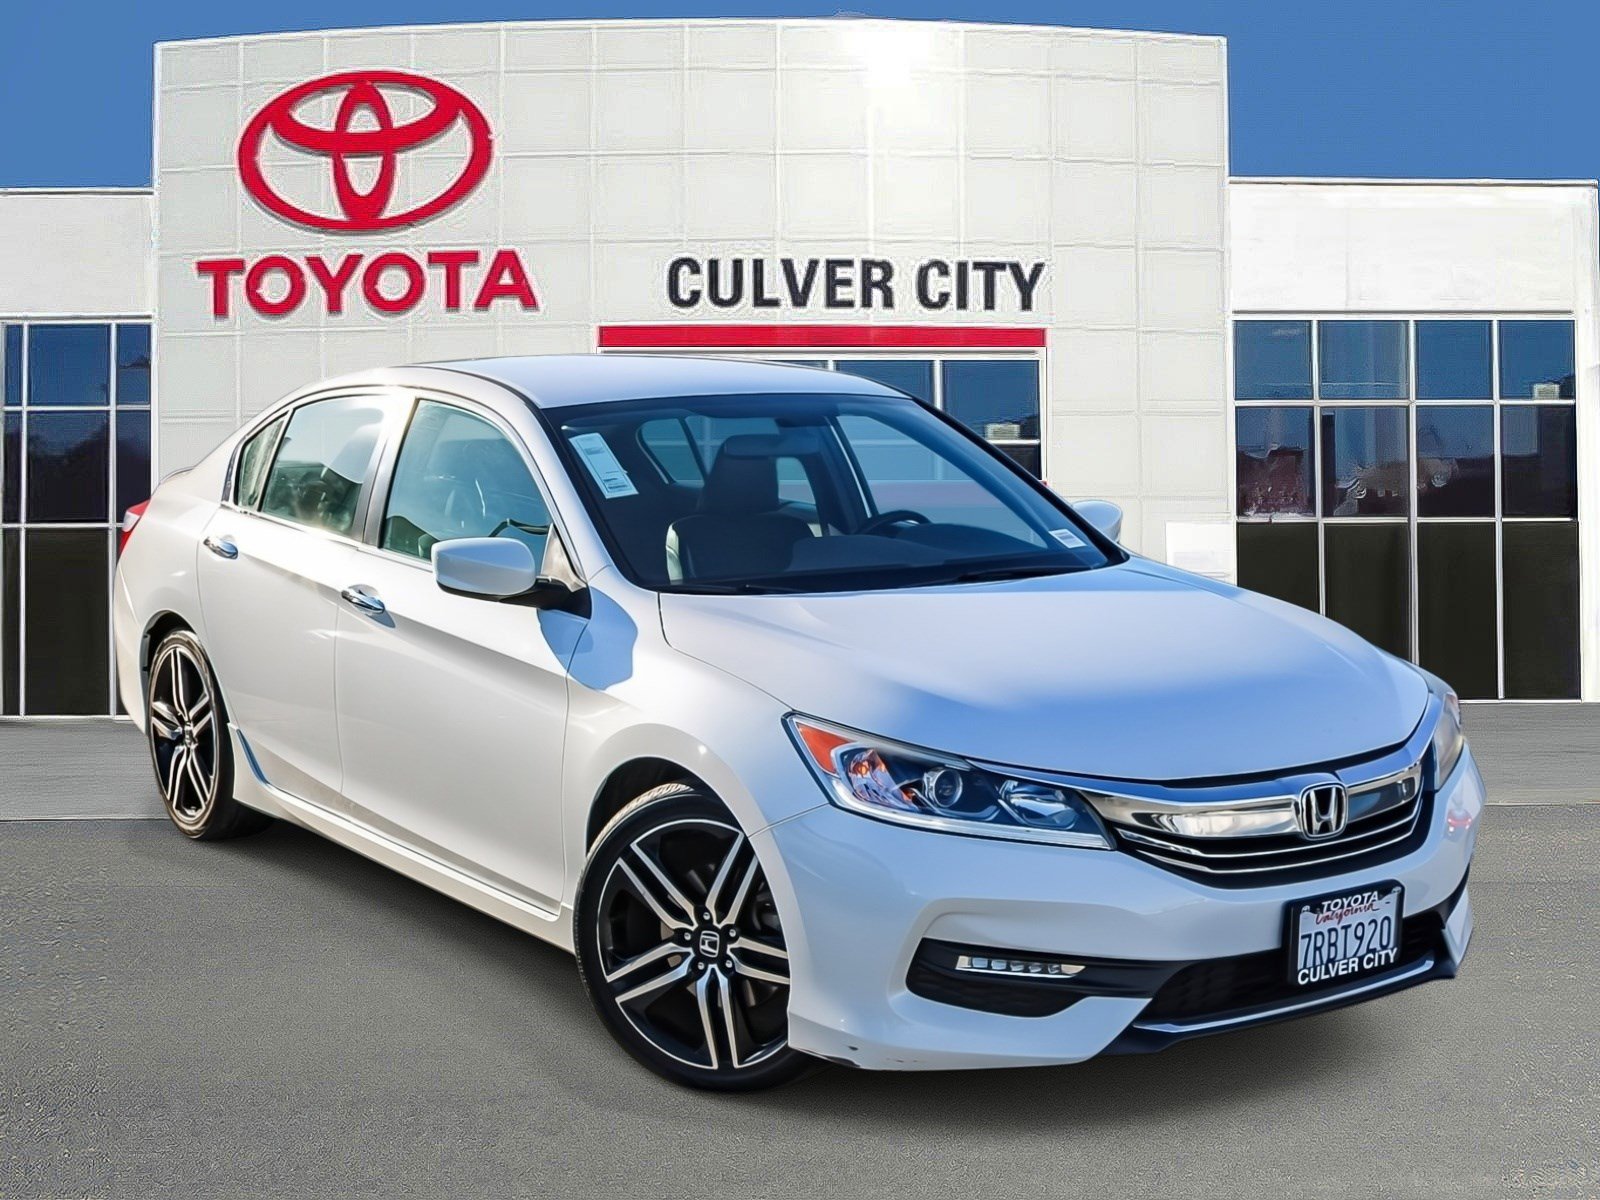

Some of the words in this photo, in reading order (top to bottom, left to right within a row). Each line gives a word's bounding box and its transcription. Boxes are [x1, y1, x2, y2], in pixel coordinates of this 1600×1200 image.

[196, 249, 540, 319] TOYOTA
[667, 257, 895, 309] CULVER
[915, 259, 1046, 312] CITY
[1322, 891, 1378, 913] TOYOTA
[1297, 957, 1358, 985] CULVER
[1363, 948, 1397, 969] CITY
[1300, 915, 1391, 968] 7RBT920
